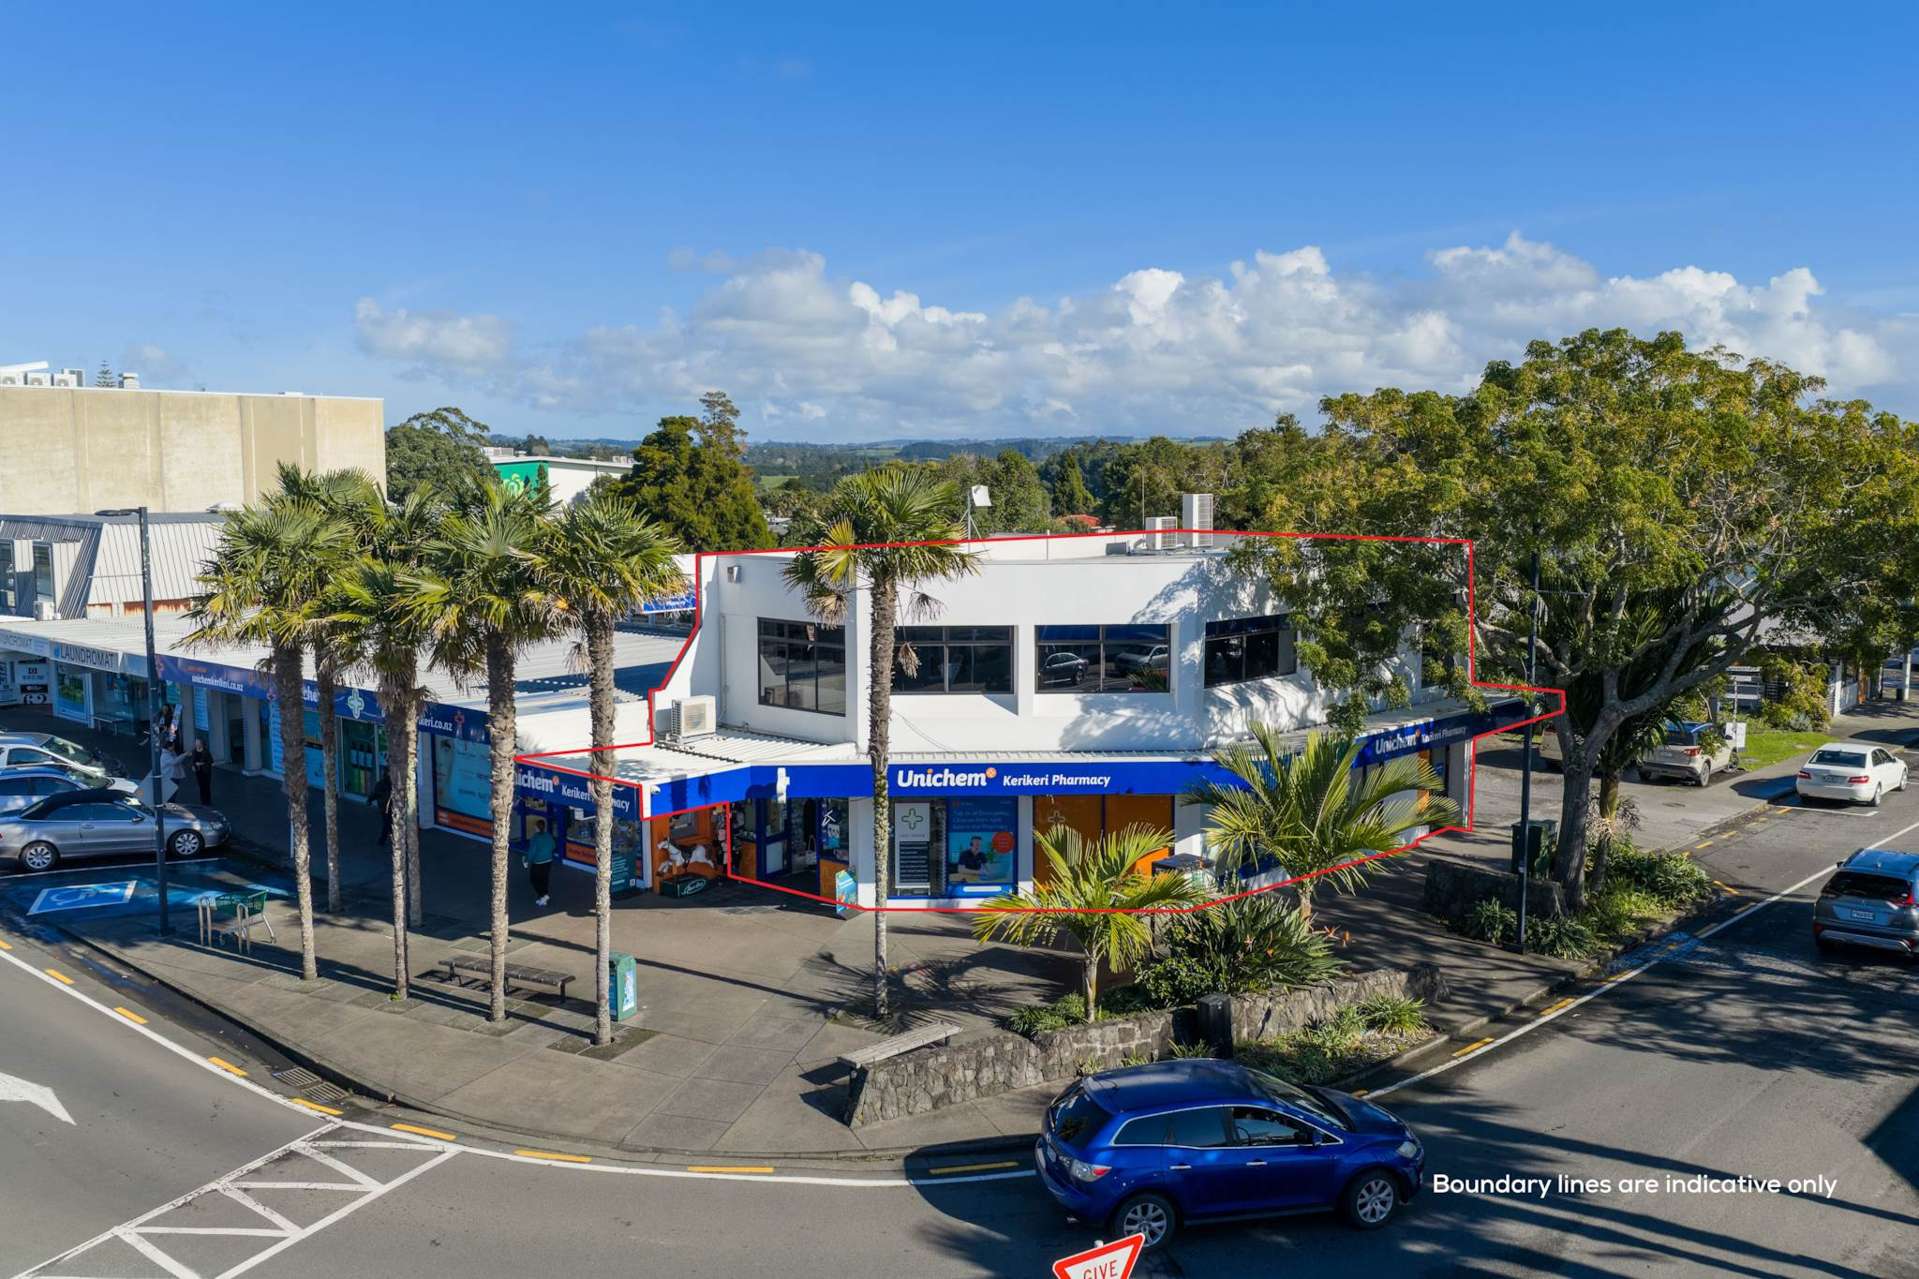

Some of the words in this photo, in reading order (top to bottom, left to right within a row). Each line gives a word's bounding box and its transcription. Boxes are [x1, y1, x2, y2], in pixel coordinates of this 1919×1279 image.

[60, 643, 114, 668] LAUNDROMAT
[897, 768, 988, 788] Unichem
[1003, 774, 1049, 787] Kerikeri
[1051, 774, 1111, 788] Pharmacy
[1083, 1259, 1118, 1279] GIVE
